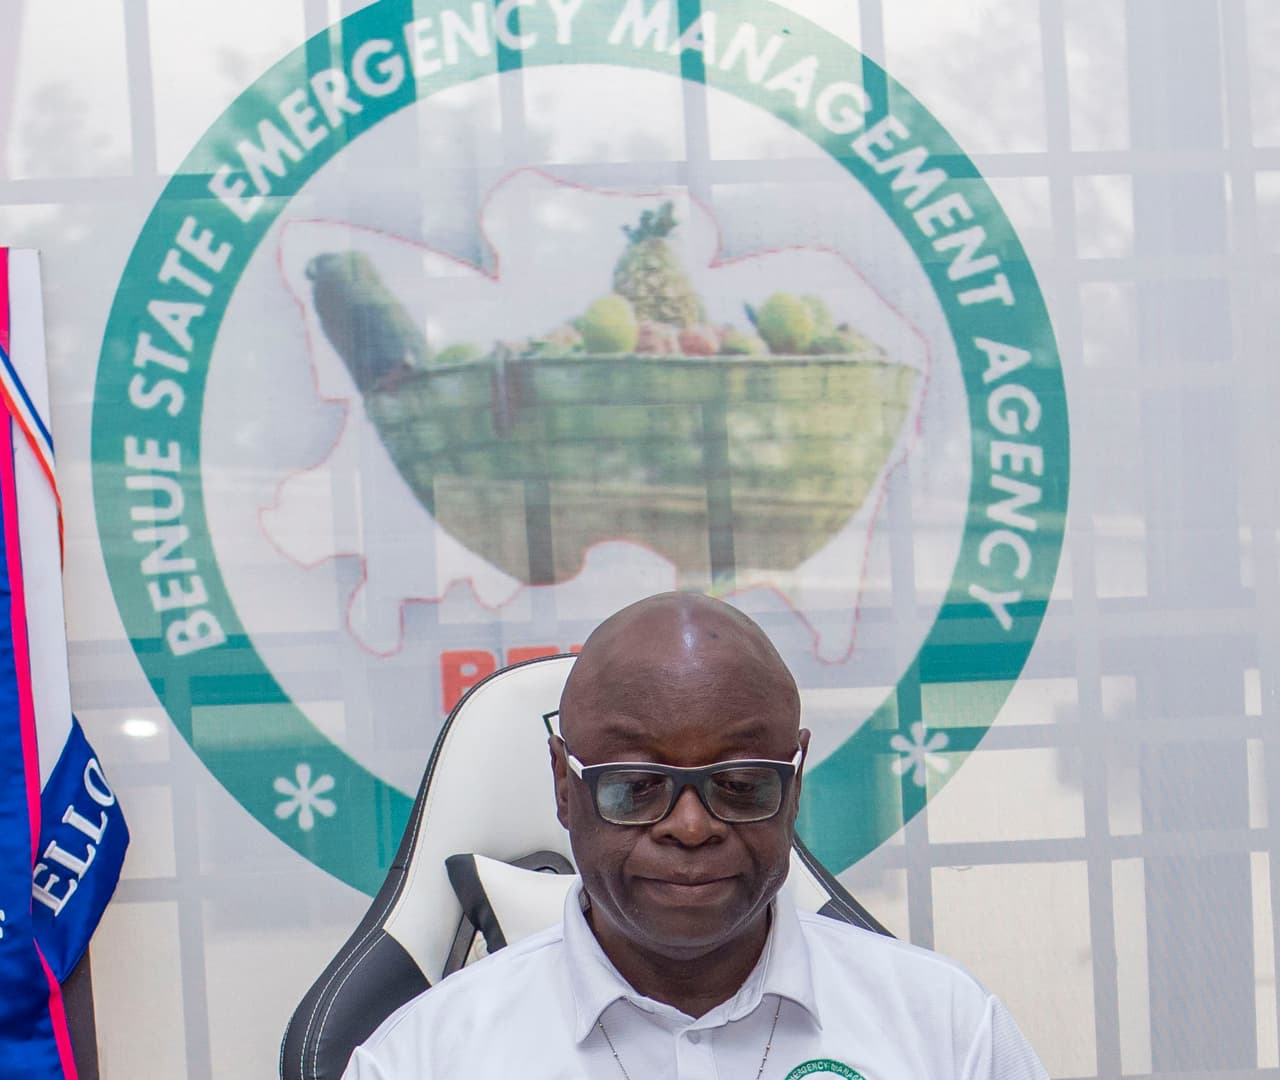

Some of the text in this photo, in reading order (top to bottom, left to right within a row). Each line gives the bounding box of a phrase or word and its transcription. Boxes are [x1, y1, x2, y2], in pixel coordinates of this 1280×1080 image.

[126, 0, 1043, 656] BENUE STATE EMERGENCY MANAGEMENT AGENCY
